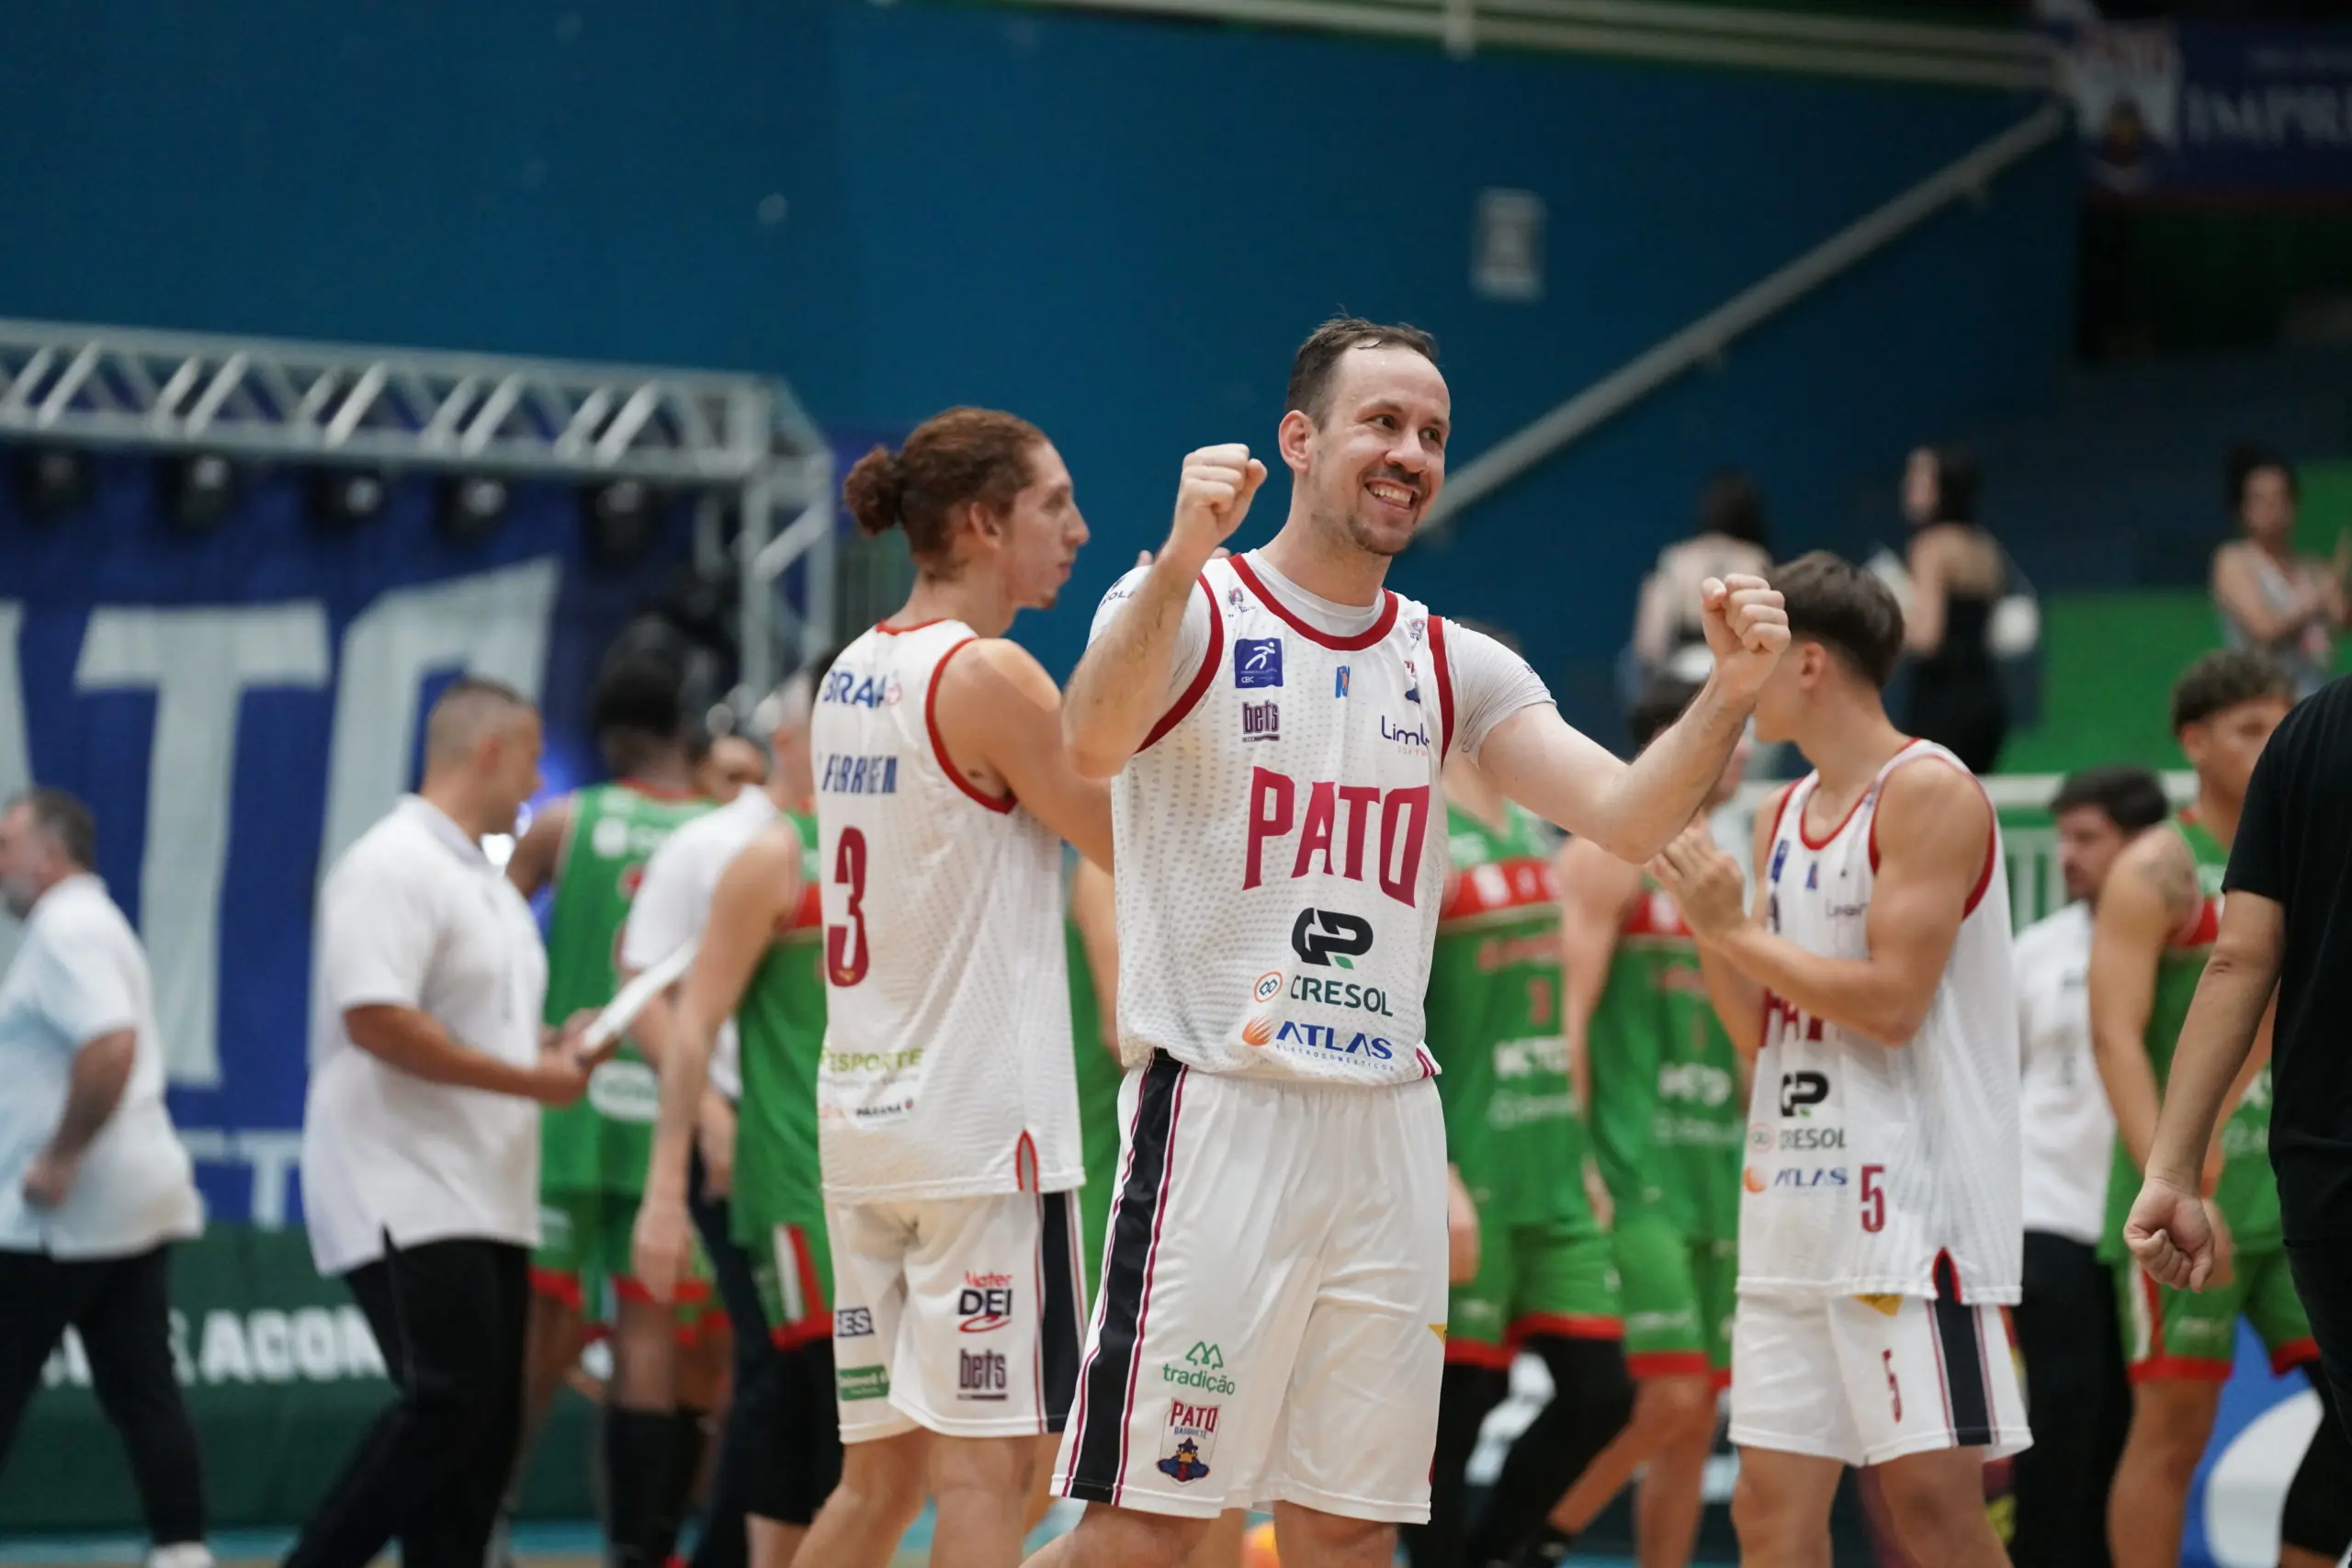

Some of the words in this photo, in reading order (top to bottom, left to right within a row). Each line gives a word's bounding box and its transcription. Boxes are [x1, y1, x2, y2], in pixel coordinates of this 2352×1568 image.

[1242, 700, 1280, 734] bets
[1242, 765, 1430, 908] PATO
[828, 826, 869, 987] 3
[1290, 975, 1394, 1017] CRESOL
[1275, 1021, 1393, 1060] ATLAS
[1774, 1167, 1849, 1187] ATLAS
[1860, 1165, 1886, 1234] 5
[958, 1289, 1012, 1316] DEI
[959, 1348, 1007, 1391] bets
[1162, 1362, 1235, 1395] tradição
[1170, 1399, 1220, 1434] PATO
